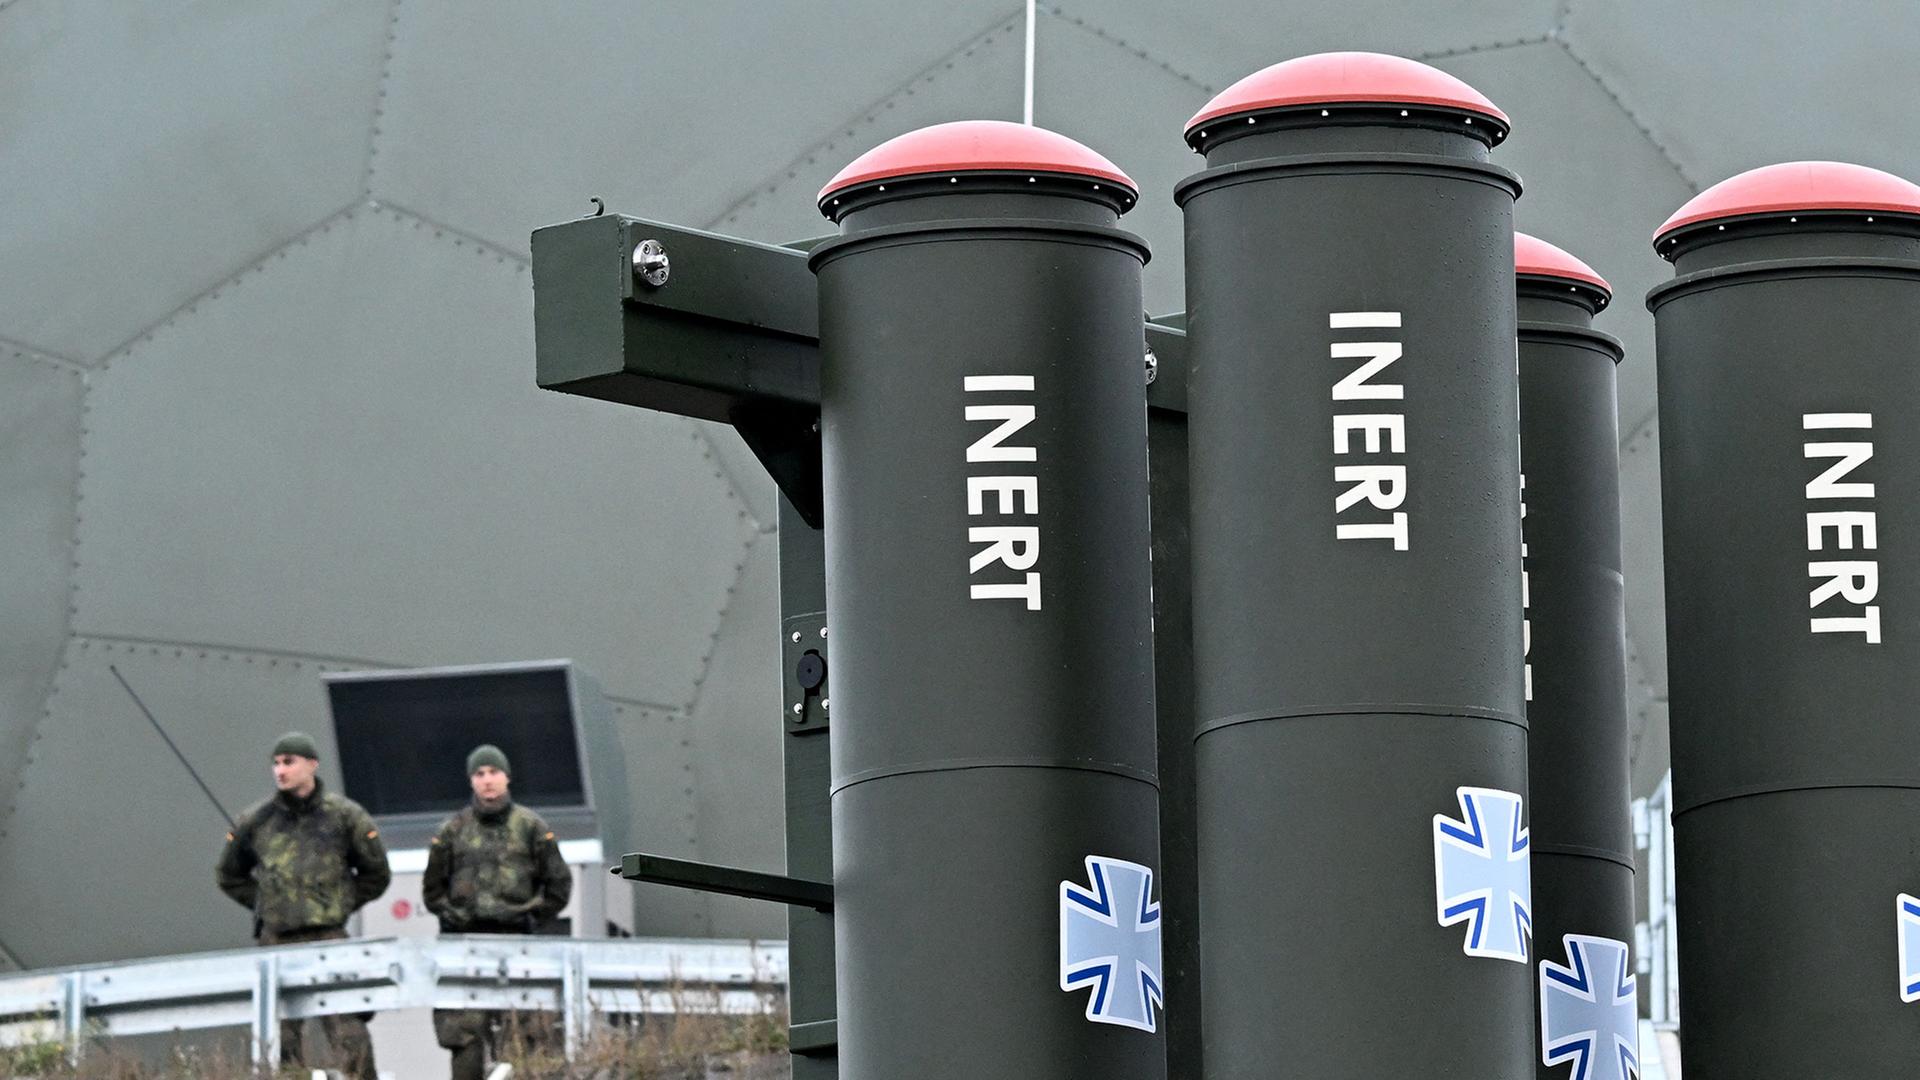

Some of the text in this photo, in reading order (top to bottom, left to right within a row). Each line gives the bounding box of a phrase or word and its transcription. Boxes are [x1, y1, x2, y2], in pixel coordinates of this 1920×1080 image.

[964, 375, 1042, 611] INERT
[1329, 311, 1409, 551] INERT
[1802, 412, 1882, 644] INERT
